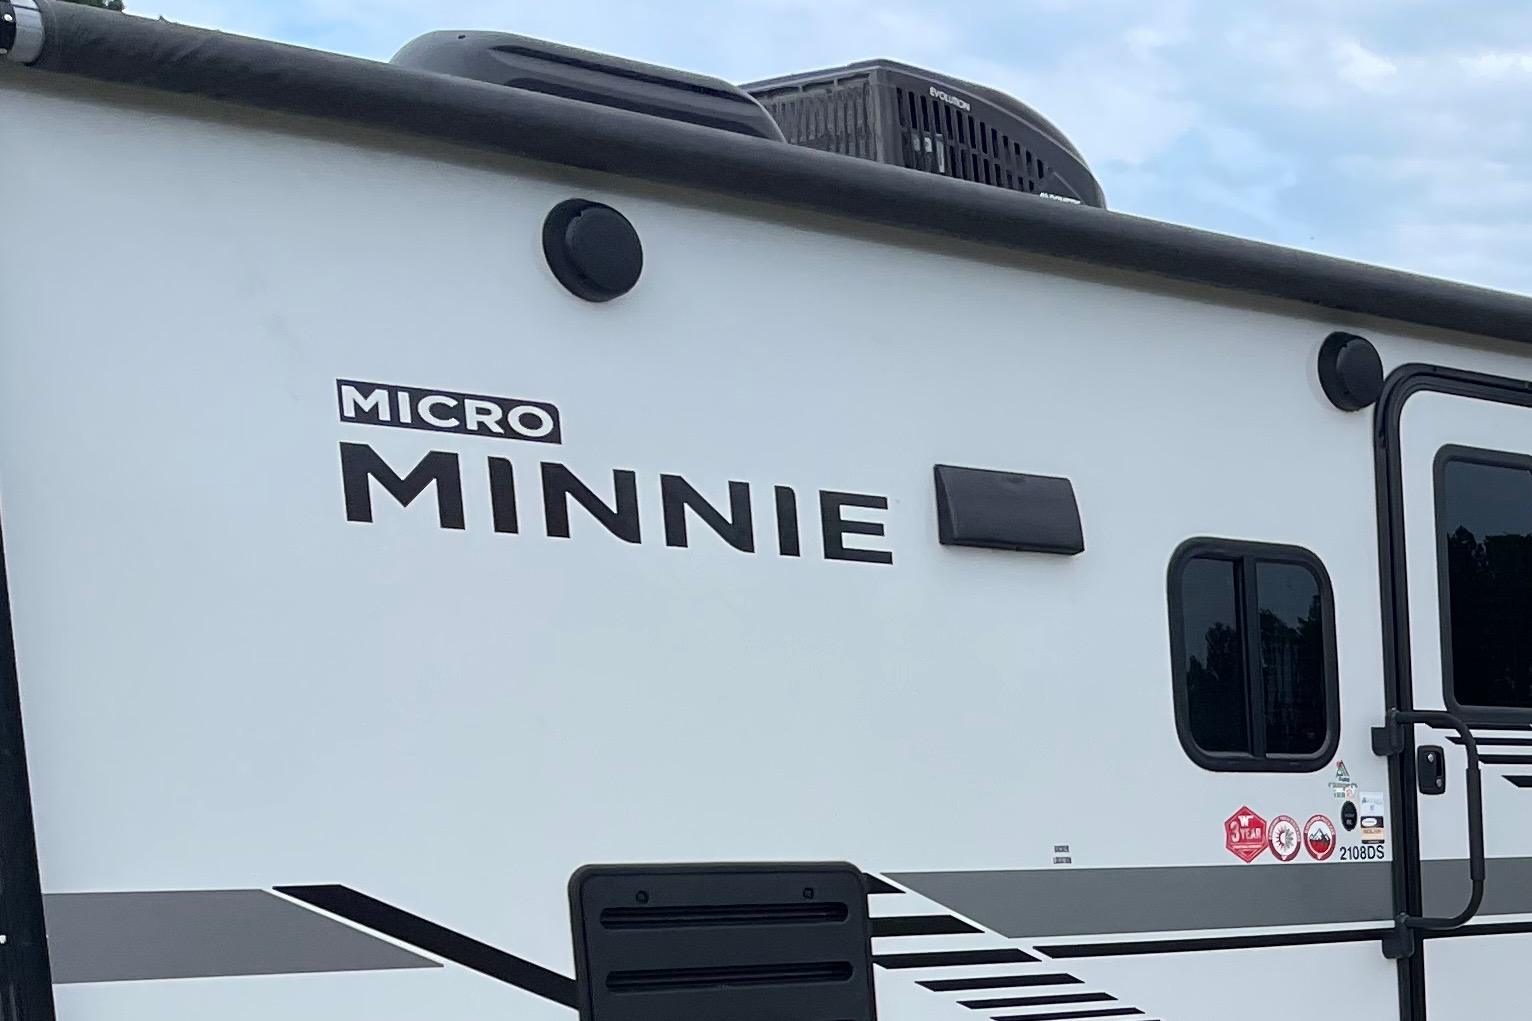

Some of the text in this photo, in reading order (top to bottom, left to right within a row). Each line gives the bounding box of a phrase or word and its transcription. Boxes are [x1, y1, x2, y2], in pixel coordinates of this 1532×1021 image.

[340, 385, 554, 437] MICRO
[340, 441, 893, 565] MINNIE
[1230, 821, 1240, 842] 3
[1241, 828, 1261, 840] YEAR
[1340, 845, 1385, 860] 2108DS
